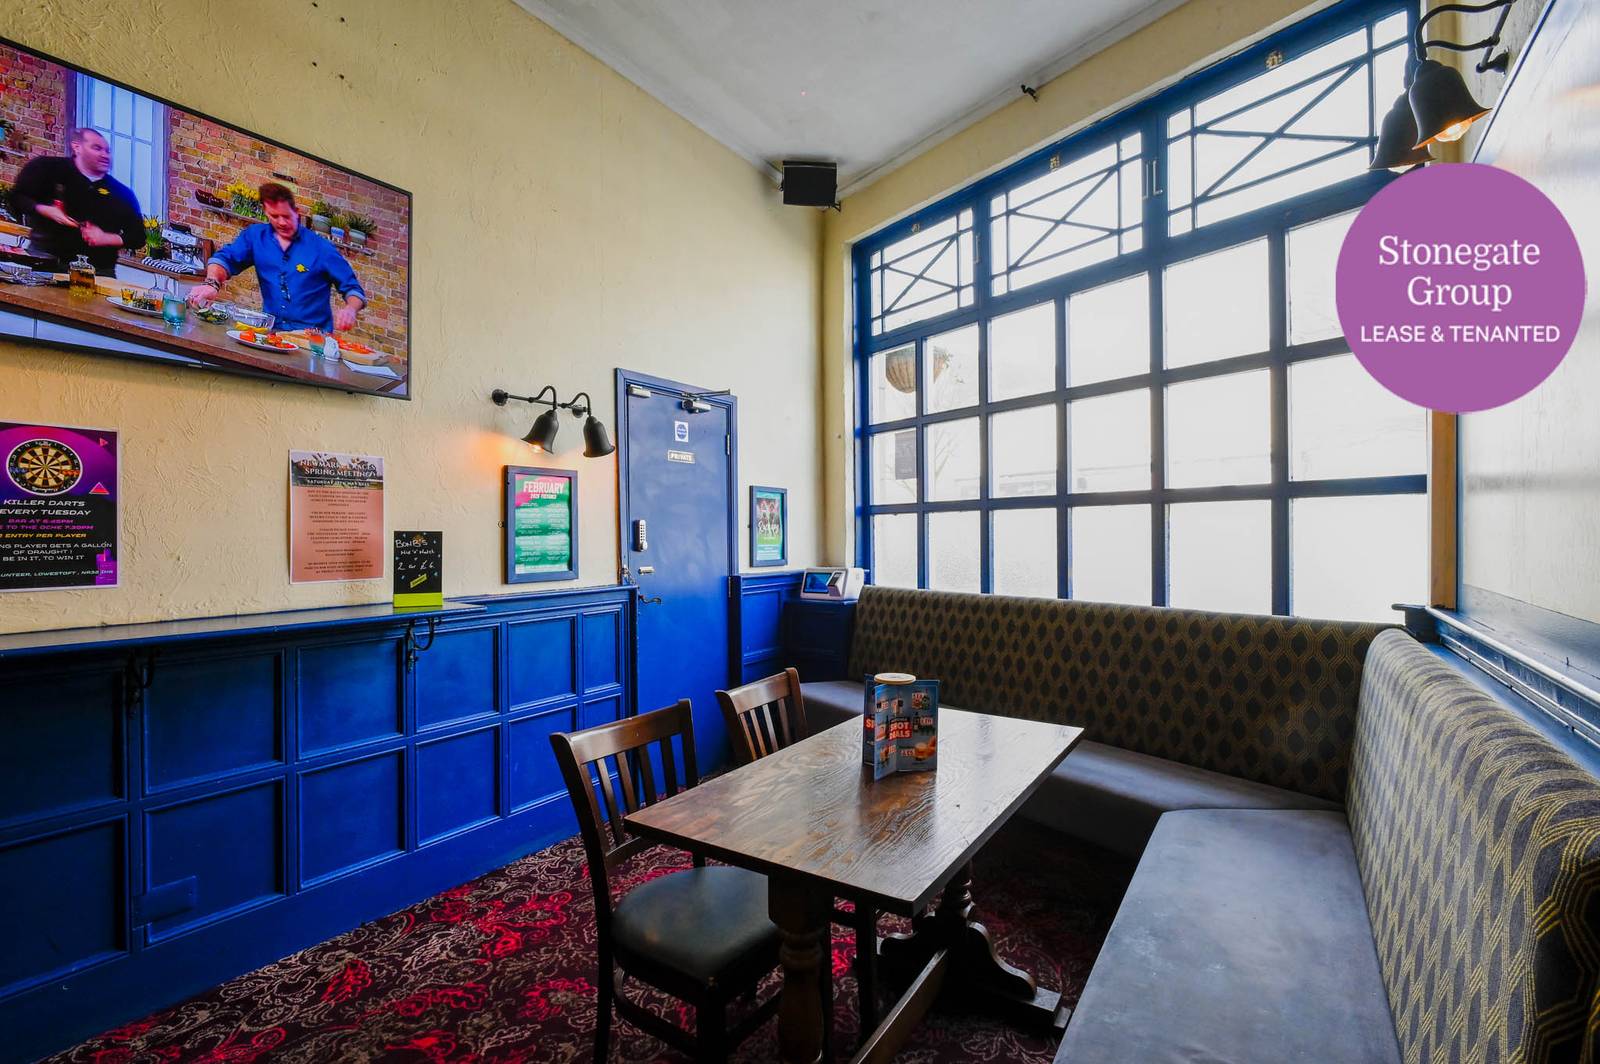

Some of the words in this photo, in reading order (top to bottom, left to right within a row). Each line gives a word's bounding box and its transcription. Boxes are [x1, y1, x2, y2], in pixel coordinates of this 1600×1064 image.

[670, 452, 692, 461] PRIVATE
[305, 468, 335, 476] SPRING
[523, 481, 565, 494] FEBRUARY
[397, 562, 406, 570] 2
